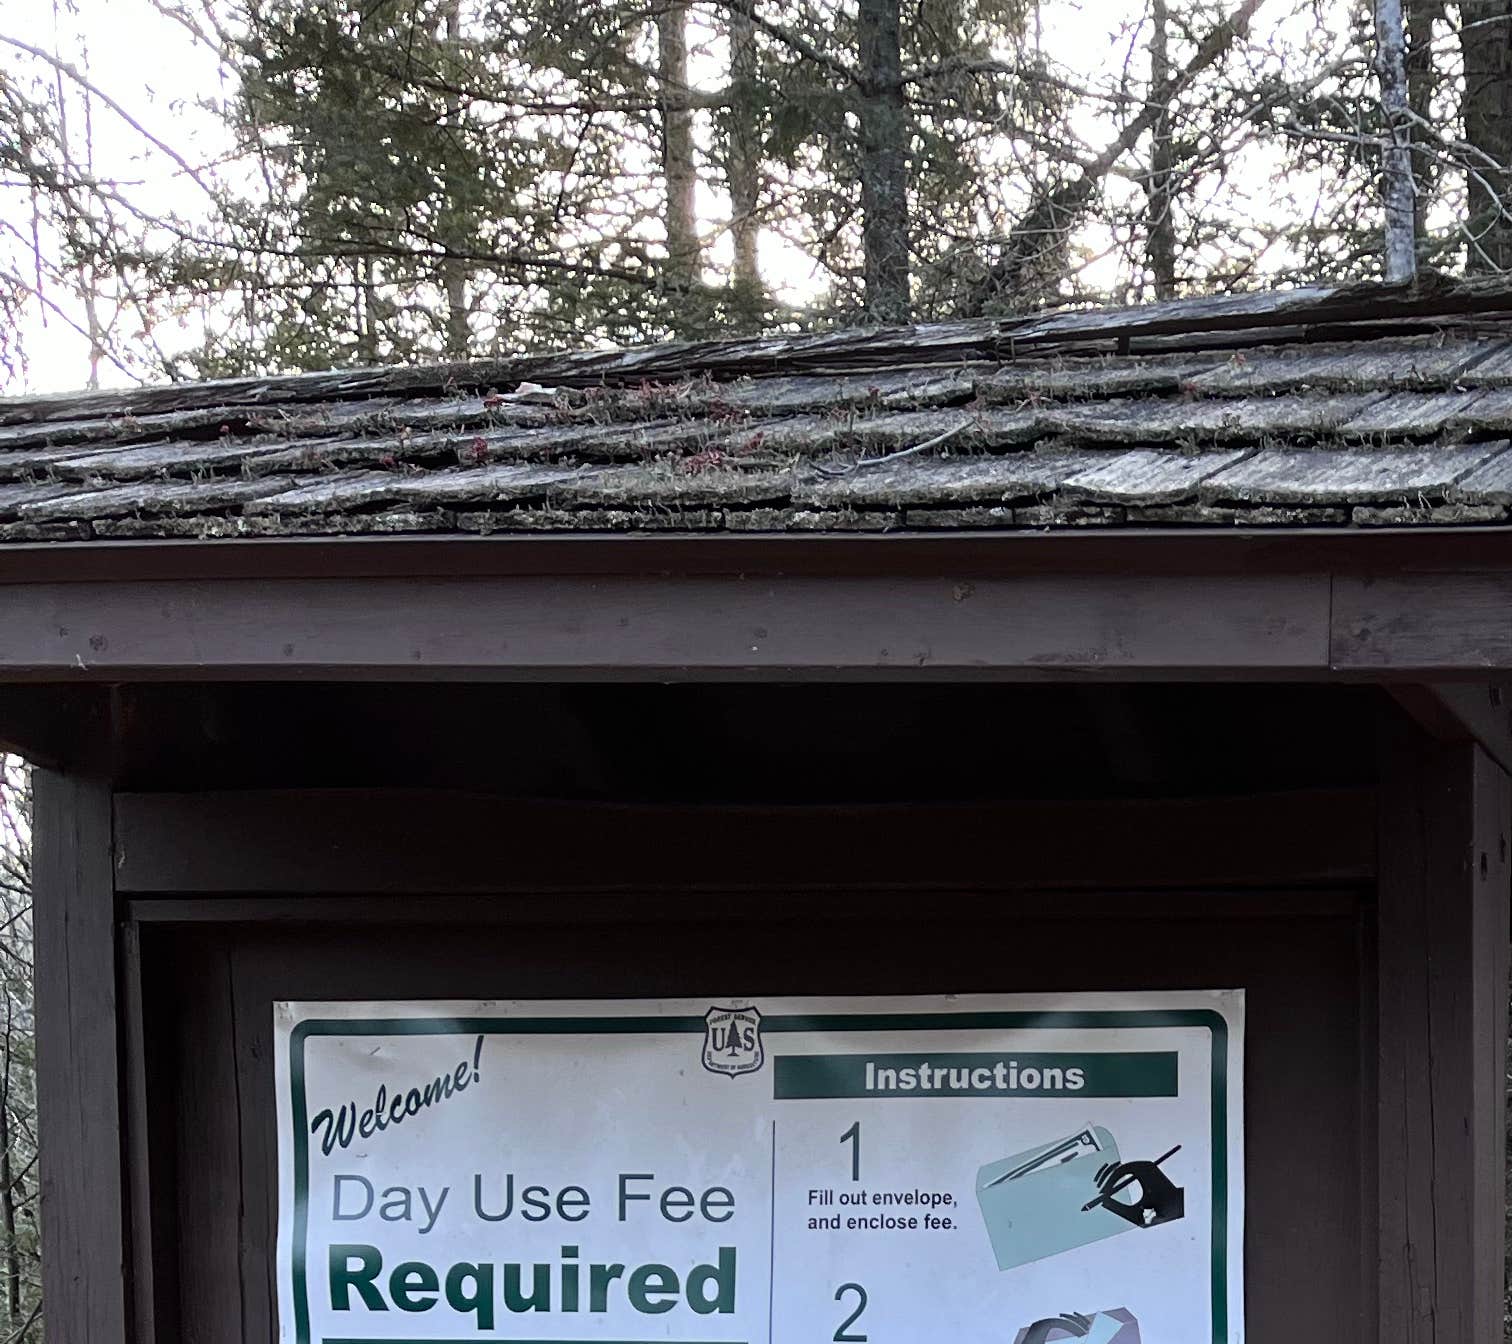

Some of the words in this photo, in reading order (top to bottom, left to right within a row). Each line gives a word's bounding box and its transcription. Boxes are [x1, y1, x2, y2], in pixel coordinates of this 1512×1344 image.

[311, 1035, 485, 1156] Welcome!
[864, 1061, 1085, 1091] Instructions
[839, 1121, 860, 1181] 1
[332, 1174, 450, 1234] Day
[473, 1174, 590, 1223] Use
[617, 1174, 735, 1223] Fee
[807, 1190, 833, 1206] Fill
[839, 1191, 867, 1206] out
[872, 1190, 958, 1211] envelope,
[807, 1214, 841, 1230] and
[846, 1214, 918, 1230] enclose
[923, 1213, 958, 1230] fee.
[328, 1244, 737, 1330] Required
[833, 1282, 868, 1342] 2
